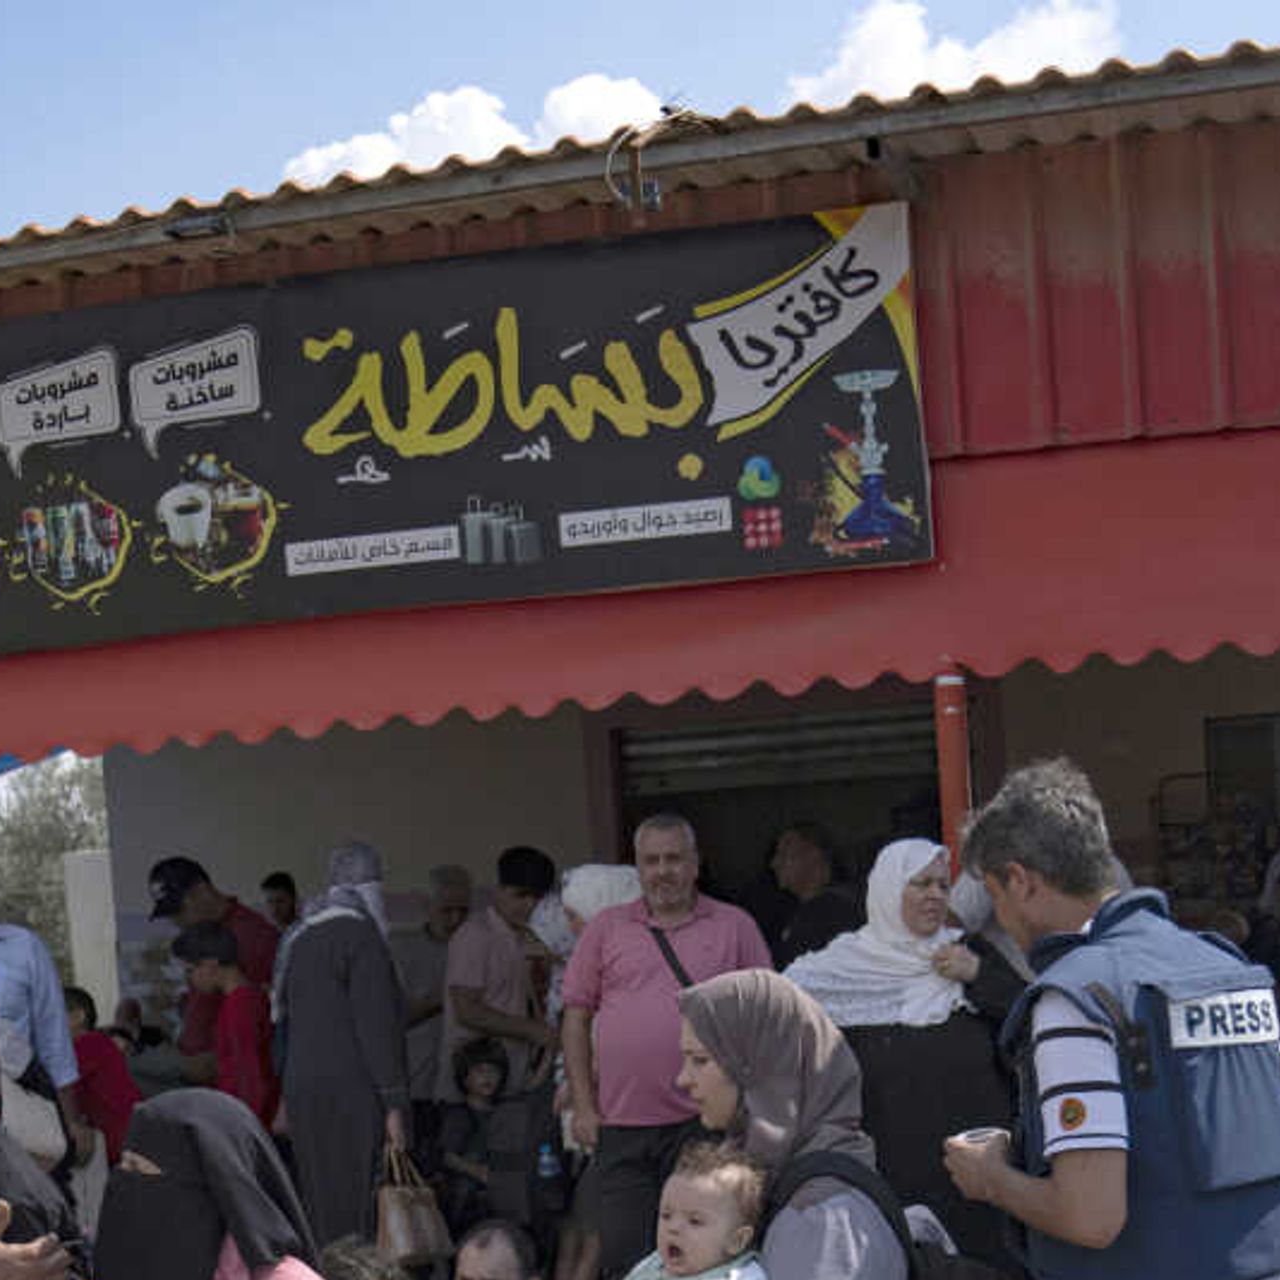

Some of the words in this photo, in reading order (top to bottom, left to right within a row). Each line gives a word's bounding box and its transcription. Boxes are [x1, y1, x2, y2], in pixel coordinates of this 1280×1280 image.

[721, 248, 878, 388] كافتريا
[152, 349, 239, 385] مشروبات
[15, 368, 99, 405] مشروبات
[165, 384, 235, 412] ساخنة
[32, 403, 91, 432] باردة
[1183, 999, 1274, 1038] PRESS
